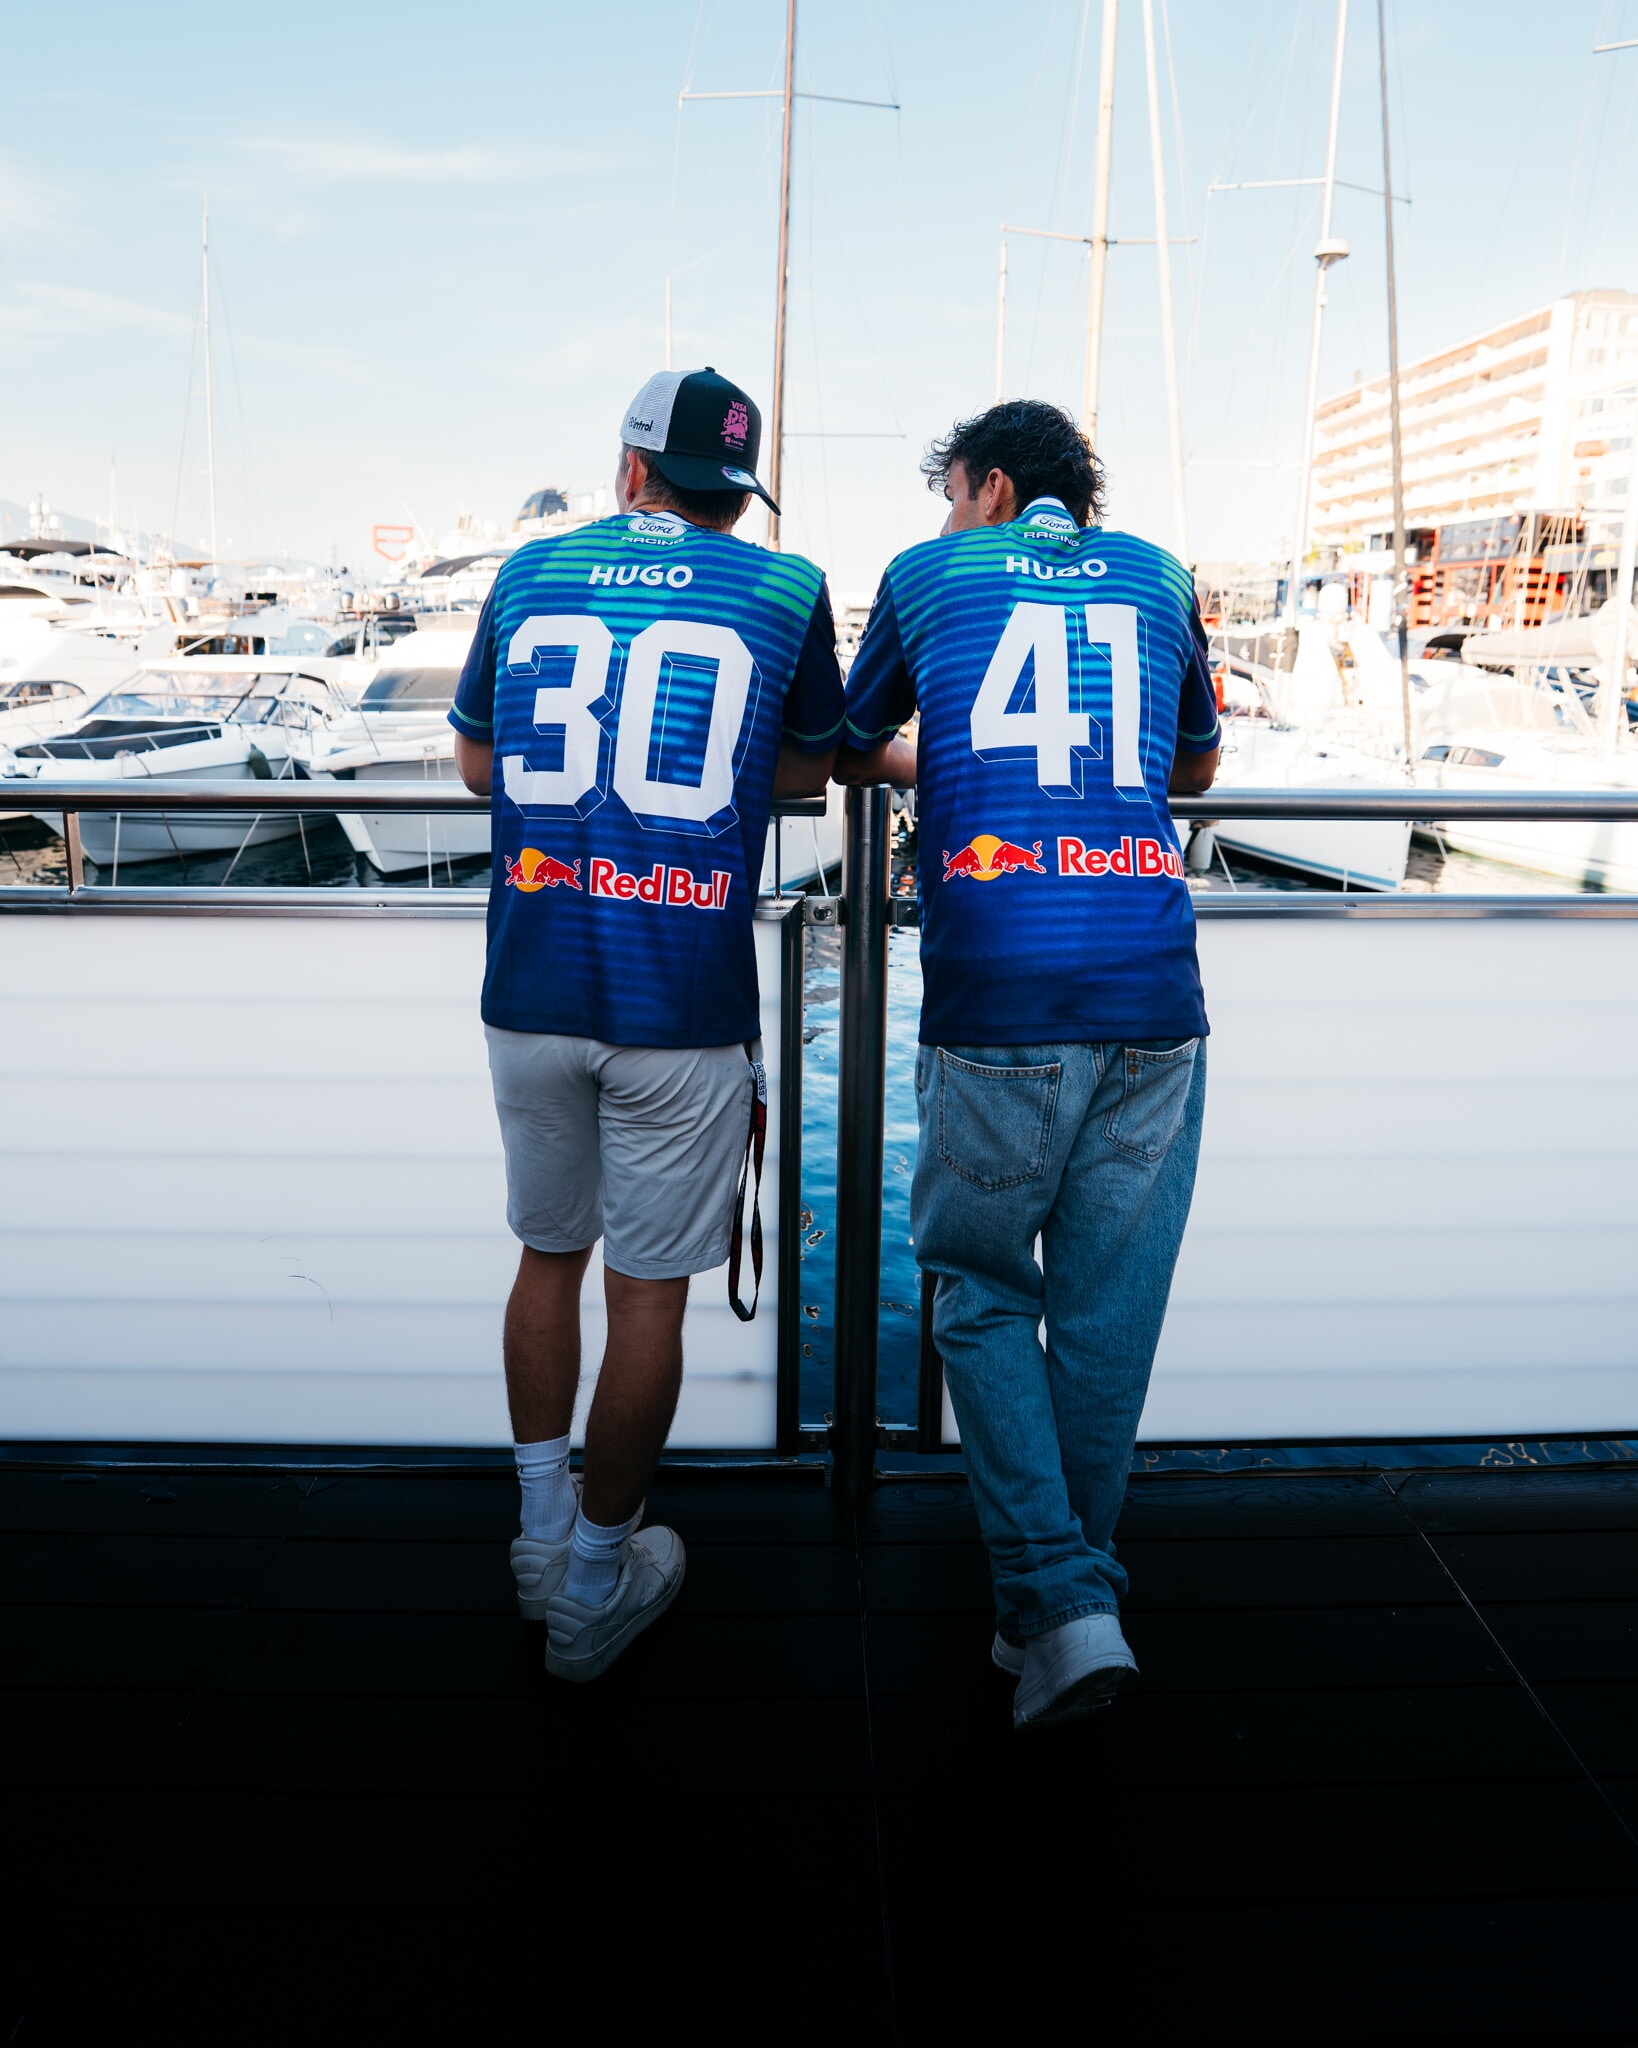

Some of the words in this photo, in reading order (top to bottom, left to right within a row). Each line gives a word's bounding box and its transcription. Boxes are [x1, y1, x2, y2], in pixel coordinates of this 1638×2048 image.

[731, 400, 747, 413] VISA
[639, 518, 675, 534] Ford
[1039, 515, 1072, 530] Ford
[1023, 531, 1080, 547] RACING
[588, 564, 694, 589] HUGO
[1006, 555, 1108, 580] HUGO
[970, 601, 1148, 792] 41
[502, 614, 760, 826] 30
[1057, 836, 1134, 877] Red
[589, 857, 666, 905] Red
[666, 866, 732, 910] Bull
[755, 1064, 766, 1096] ACCESS
